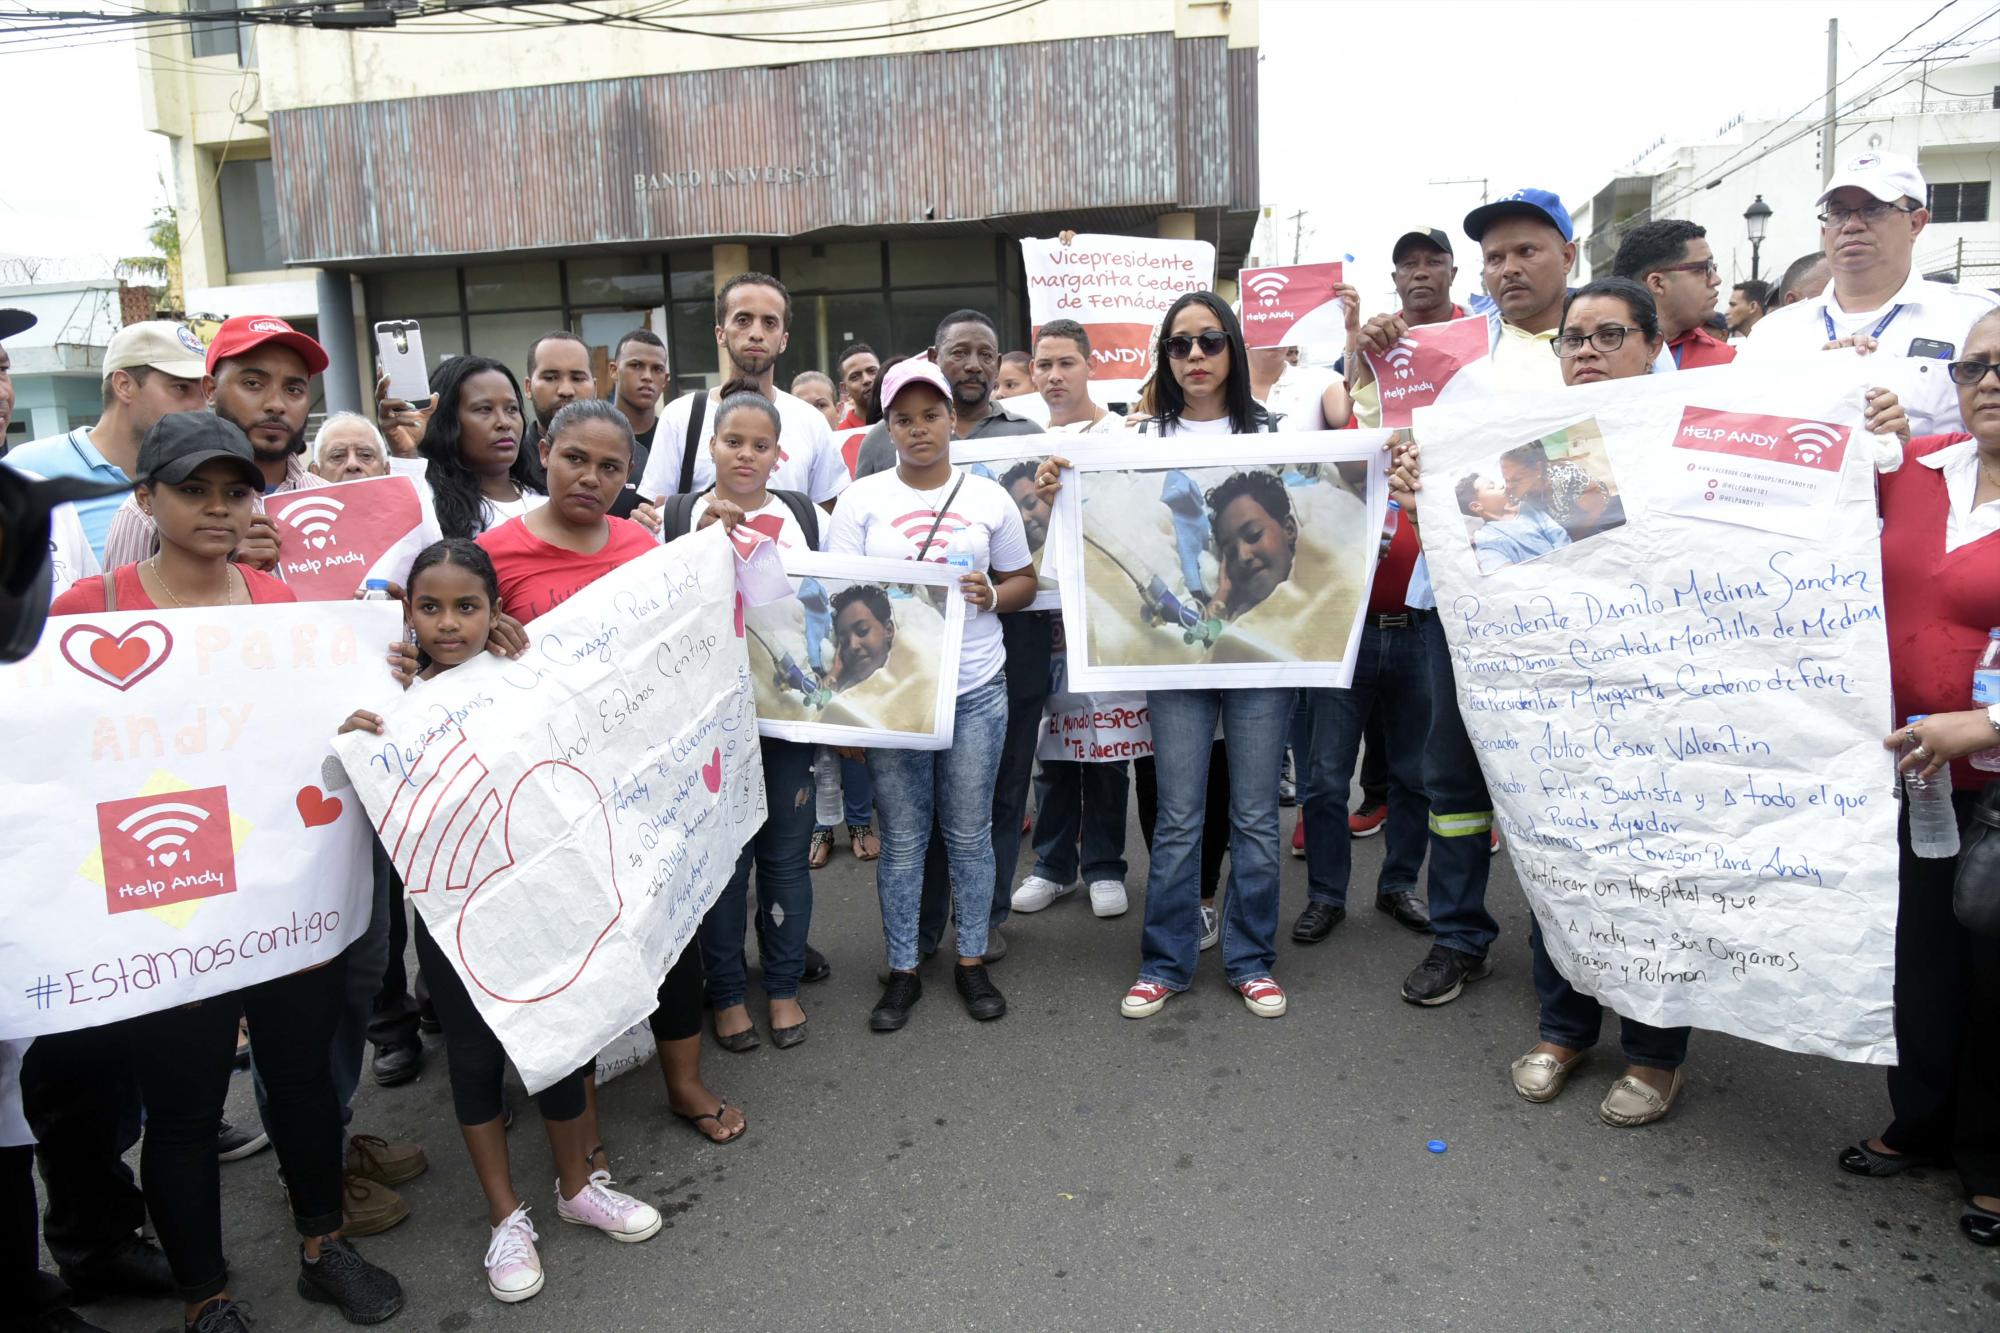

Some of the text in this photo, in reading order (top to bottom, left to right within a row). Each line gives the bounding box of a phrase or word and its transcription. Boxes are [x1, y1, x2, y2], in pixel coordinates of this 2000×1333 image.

[634, 159, 837, 192] BANCO UNIVERSAL
[1049, 249, 1194, 272] Vicepresidente
[1137, 274, 1209, 292] Cedeño
[1057, 293, 1078, 309] de
[1246, 310, 1294, 323] Help Andy
[1092, 347, 1147, 368] ANDY
[1384, 380, 1435, 400] Help Andy
[1682, 425, 1779, 450] HELP ANDY
[288, 550, 366, 576] Help Andy
[1570, 583, 1664, 633] Danilo
[1769, 550, 1868, 612] Sanchez
[1772, 616, 1796, 639] de
[656, 634, 718, 679] Contigo
[1767, 669, 1797, 693] de
[1529, 721, 1587, 765] Julio
[1593, 724, 1657, 761] Cesar
[1664, 723, 1771, 761] Valentin
[1539, 768, 1591, 801] Felix
[1593, 771, 1683, 805] Bautista
[1695, 794, 1706, 811] y
[1743, 773, 1797, 808] todo
[1808, 784, 1827, 806] el
[1834, 793, 1869, 816] que
[1759, 846, 1824, 886] Andy
[118, 867, 225, 900] Help Andy
[1628, 873, 1700, 908] Hospital
[1711, 892, 1757, 915] que
[1588, 920, 1627, 953] Andy
[1643, 937, 1656, 952] y
[1620, 965, 1629, 984] y
